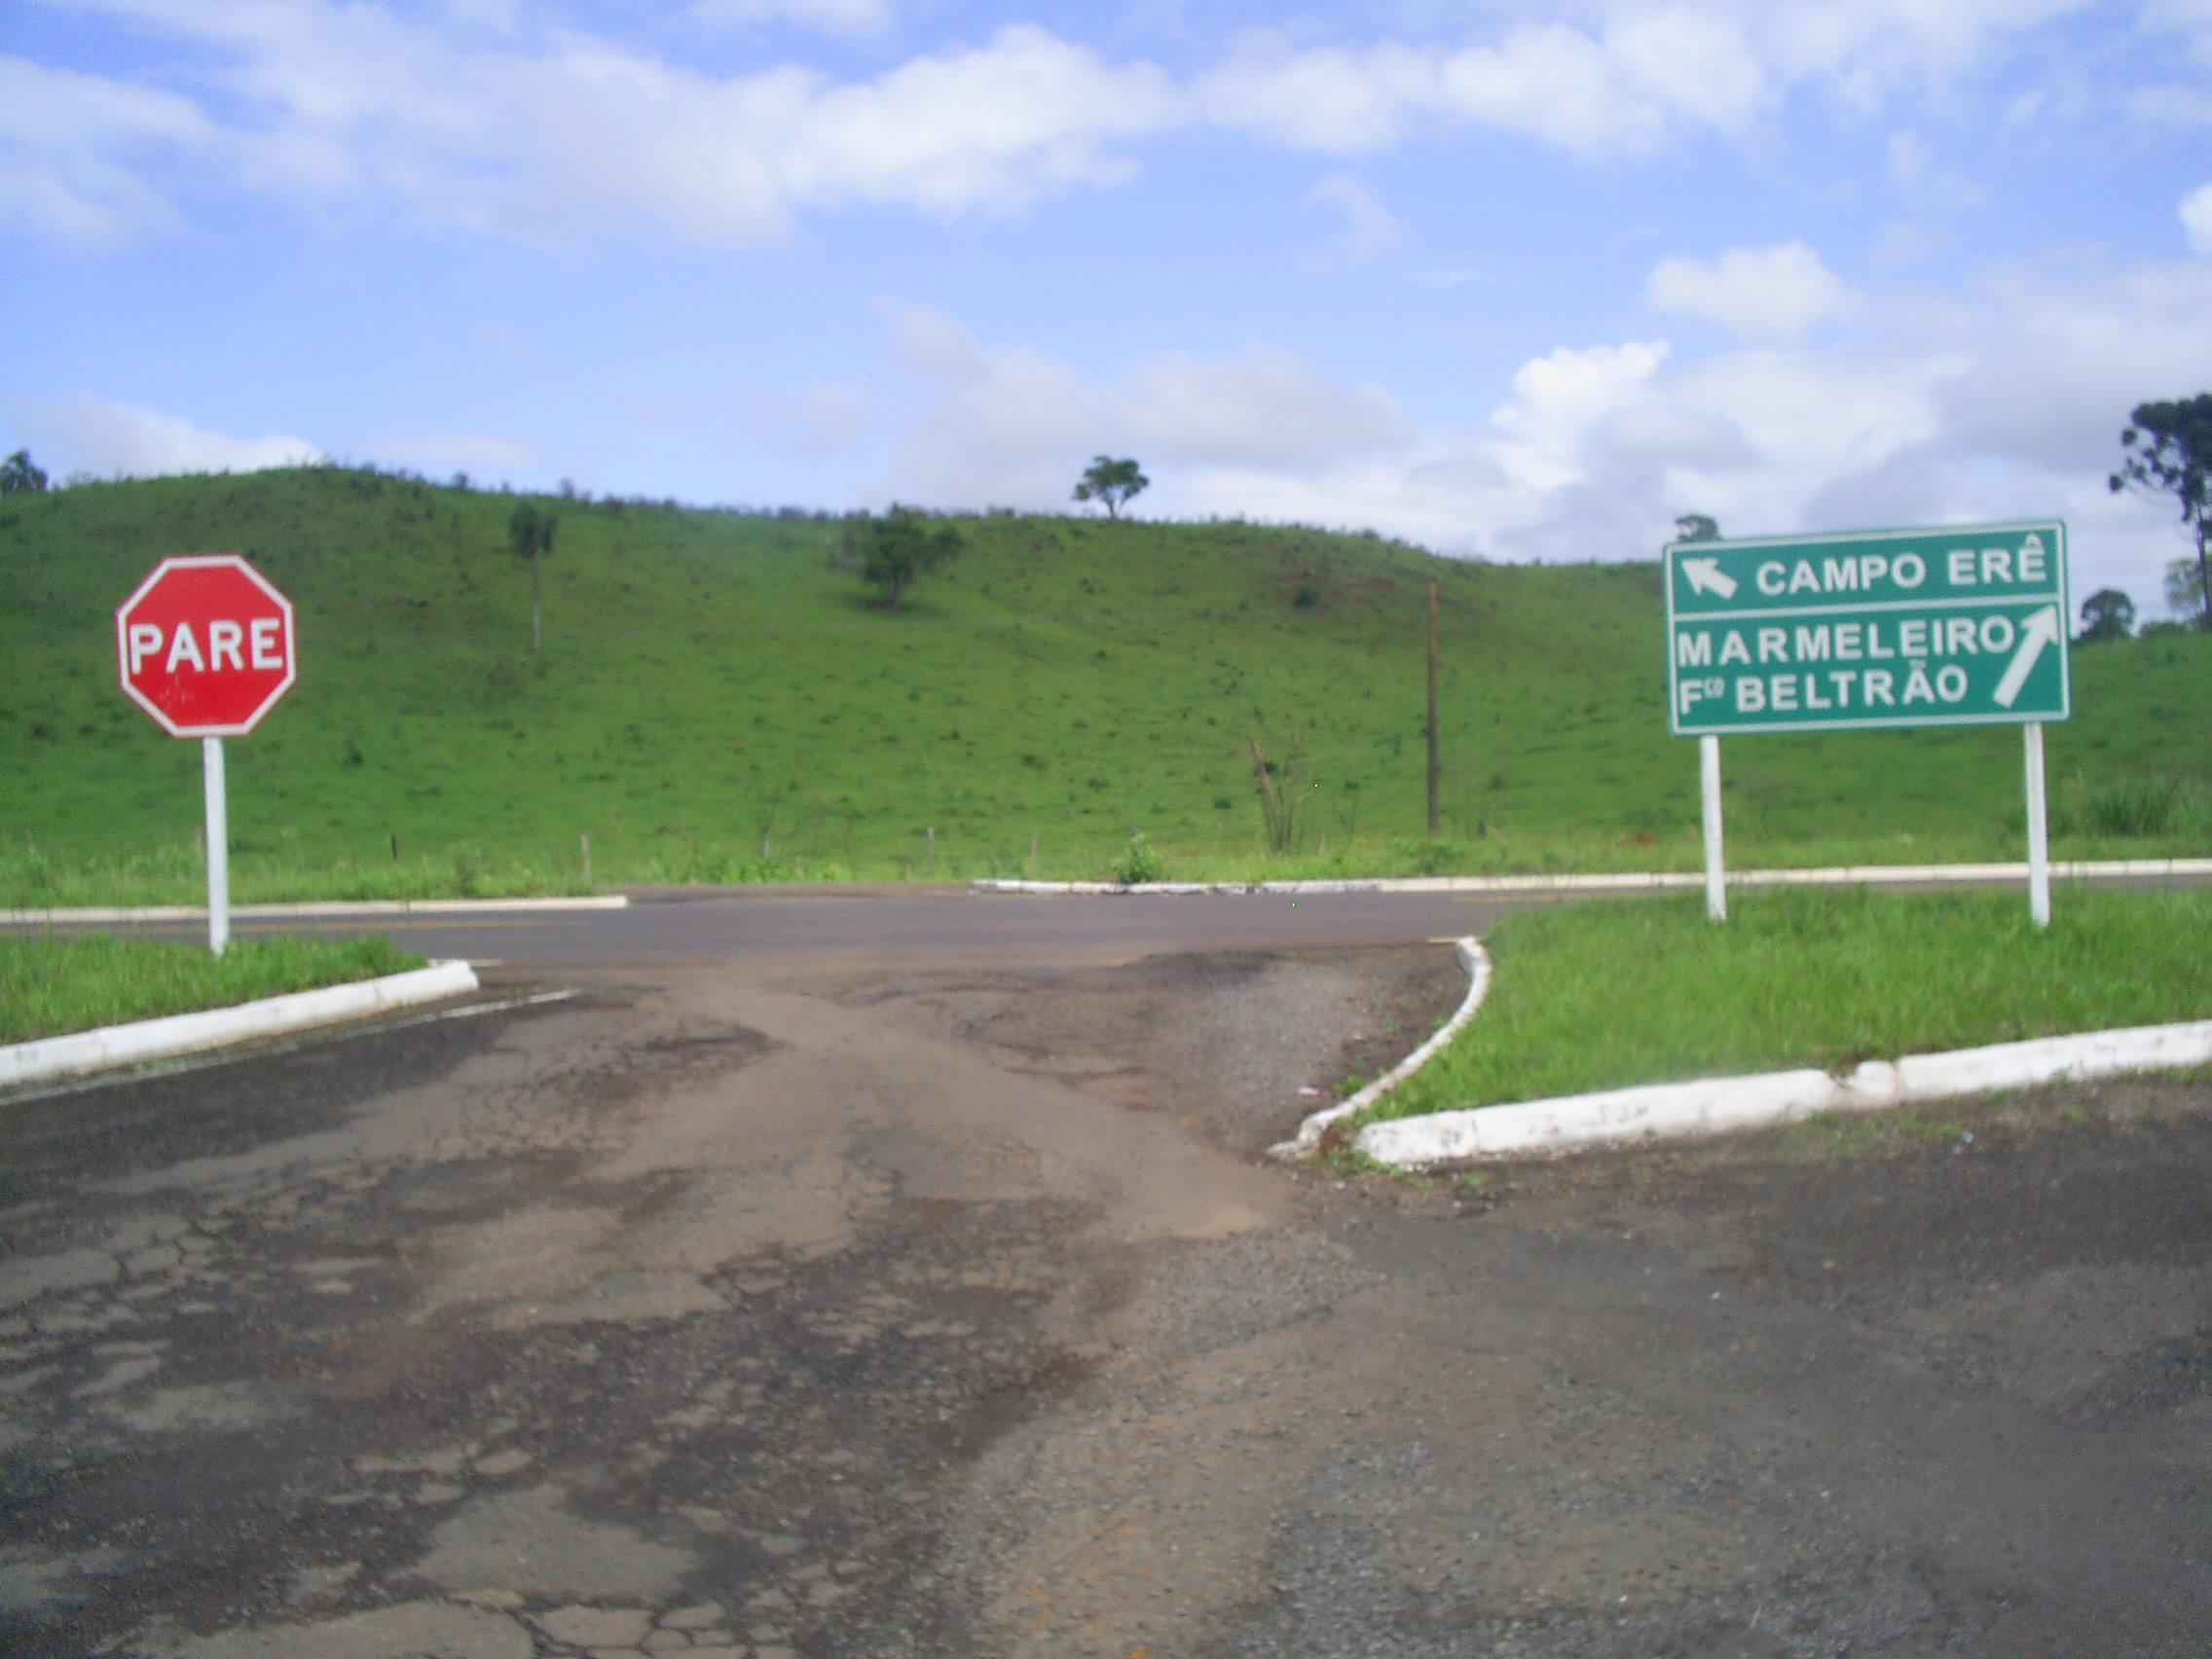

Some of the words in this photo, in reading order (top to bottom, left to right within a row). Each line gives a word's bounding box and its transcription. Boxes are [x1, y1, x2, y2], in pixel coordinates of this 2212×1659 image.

[1756, 552, 1926, 596] CAMPO
[1947, 533, 2046, 586] ERÊ
[129, 617, 284, 675] PARE
[1677, 614, 2015, 667] MARMELEIRO
[1736, 660, 1969, 713] BELTRÃO
